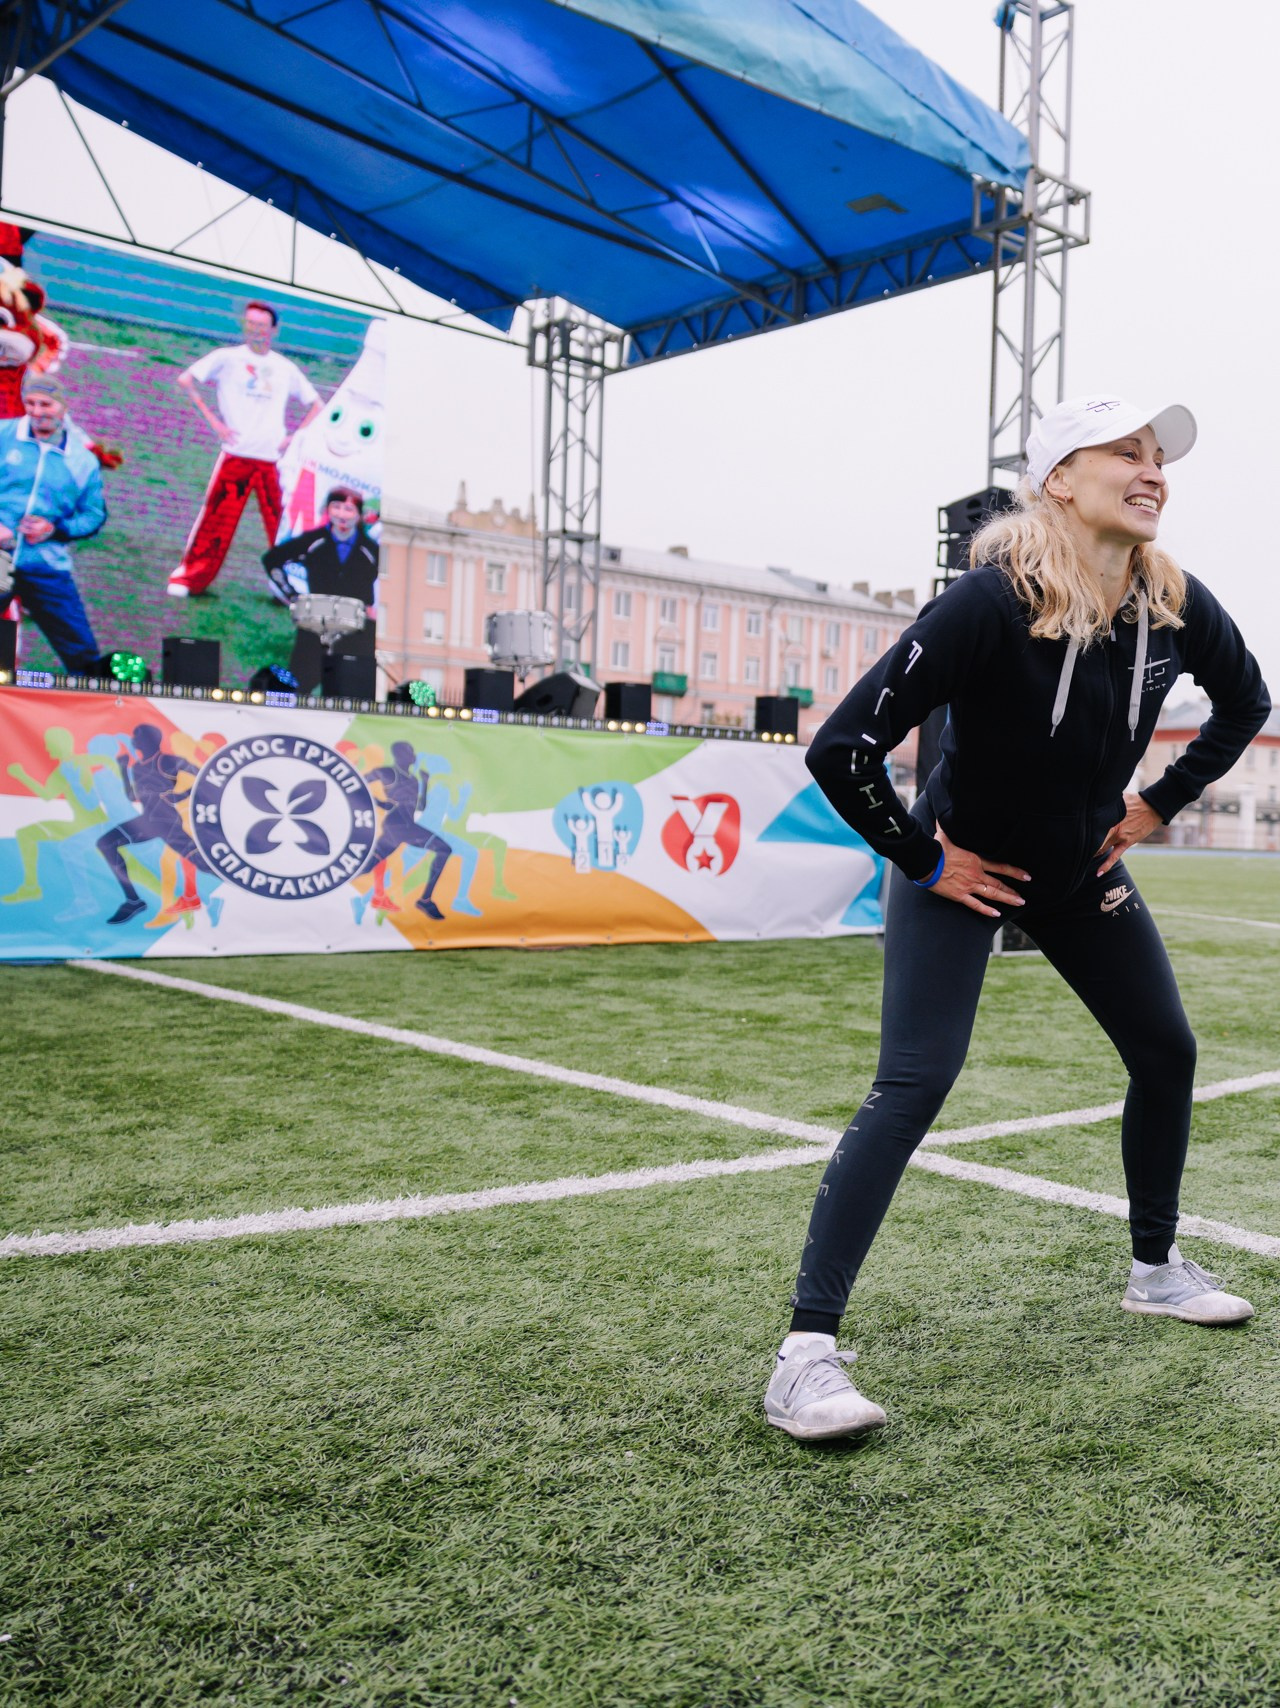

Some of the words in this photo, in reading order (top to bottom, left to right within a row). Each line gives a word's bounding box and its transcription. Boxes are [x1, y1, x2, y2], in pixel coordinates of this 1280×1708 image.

[1140, 683, 1166, 693] LIGHT
[205, 738, 286, 788] КОМОС
[293, 740, 362, 794] ГРУПП
[210, 842, 367, 896] СПАРТАКИАДА
[1104, 884, 1128, 903] NIKE
[1112, 902, 1140, 917] AIR
